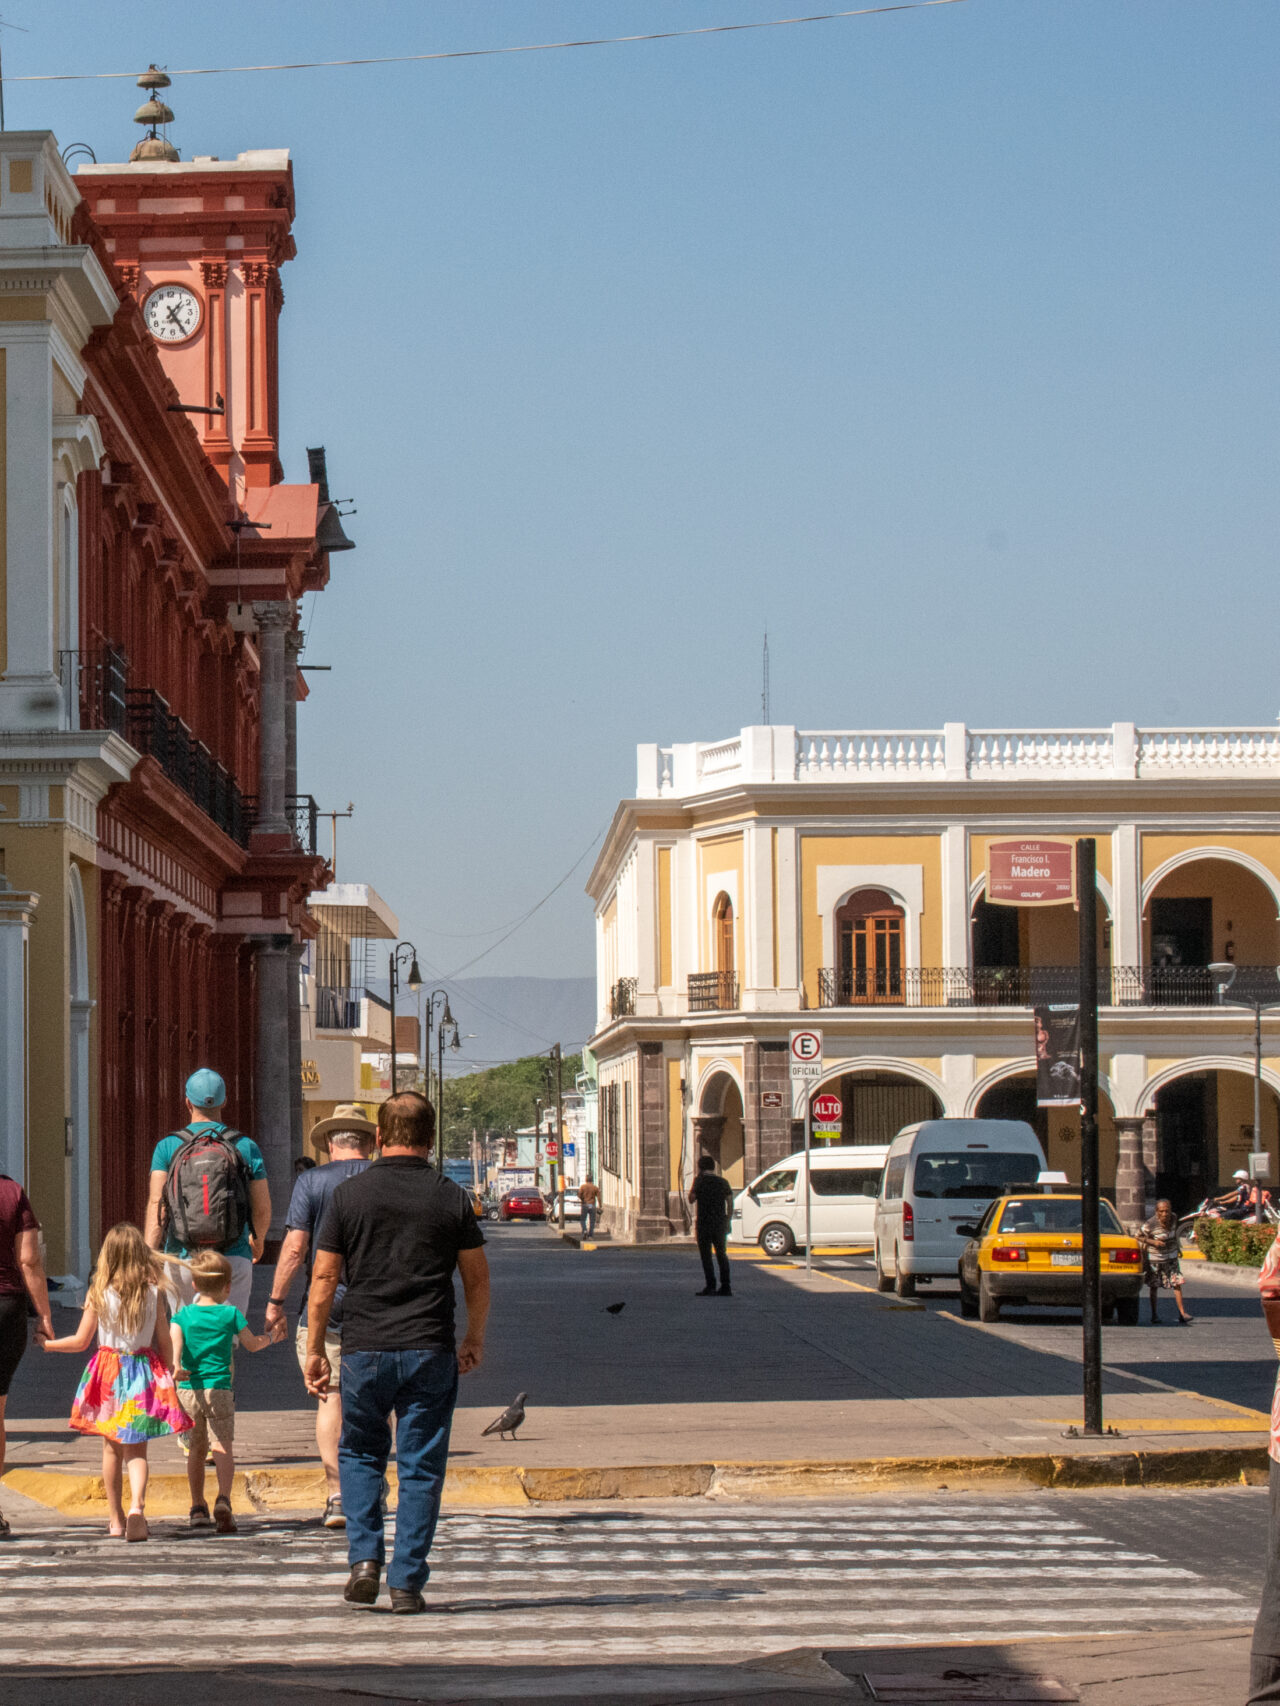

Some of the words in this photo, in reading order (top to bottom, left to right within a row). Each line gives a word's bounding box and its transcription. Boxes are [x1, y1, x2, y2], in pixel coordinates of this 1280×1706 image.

[1011, 854, 1044, 864] Francisco
[1011, 866, 1051, 877] Madero
[801, 1038, 812, 1054] E
[793, 1067, 820, 1076] OFICIAL
[814, 1103, 841, 1114] ALTO
